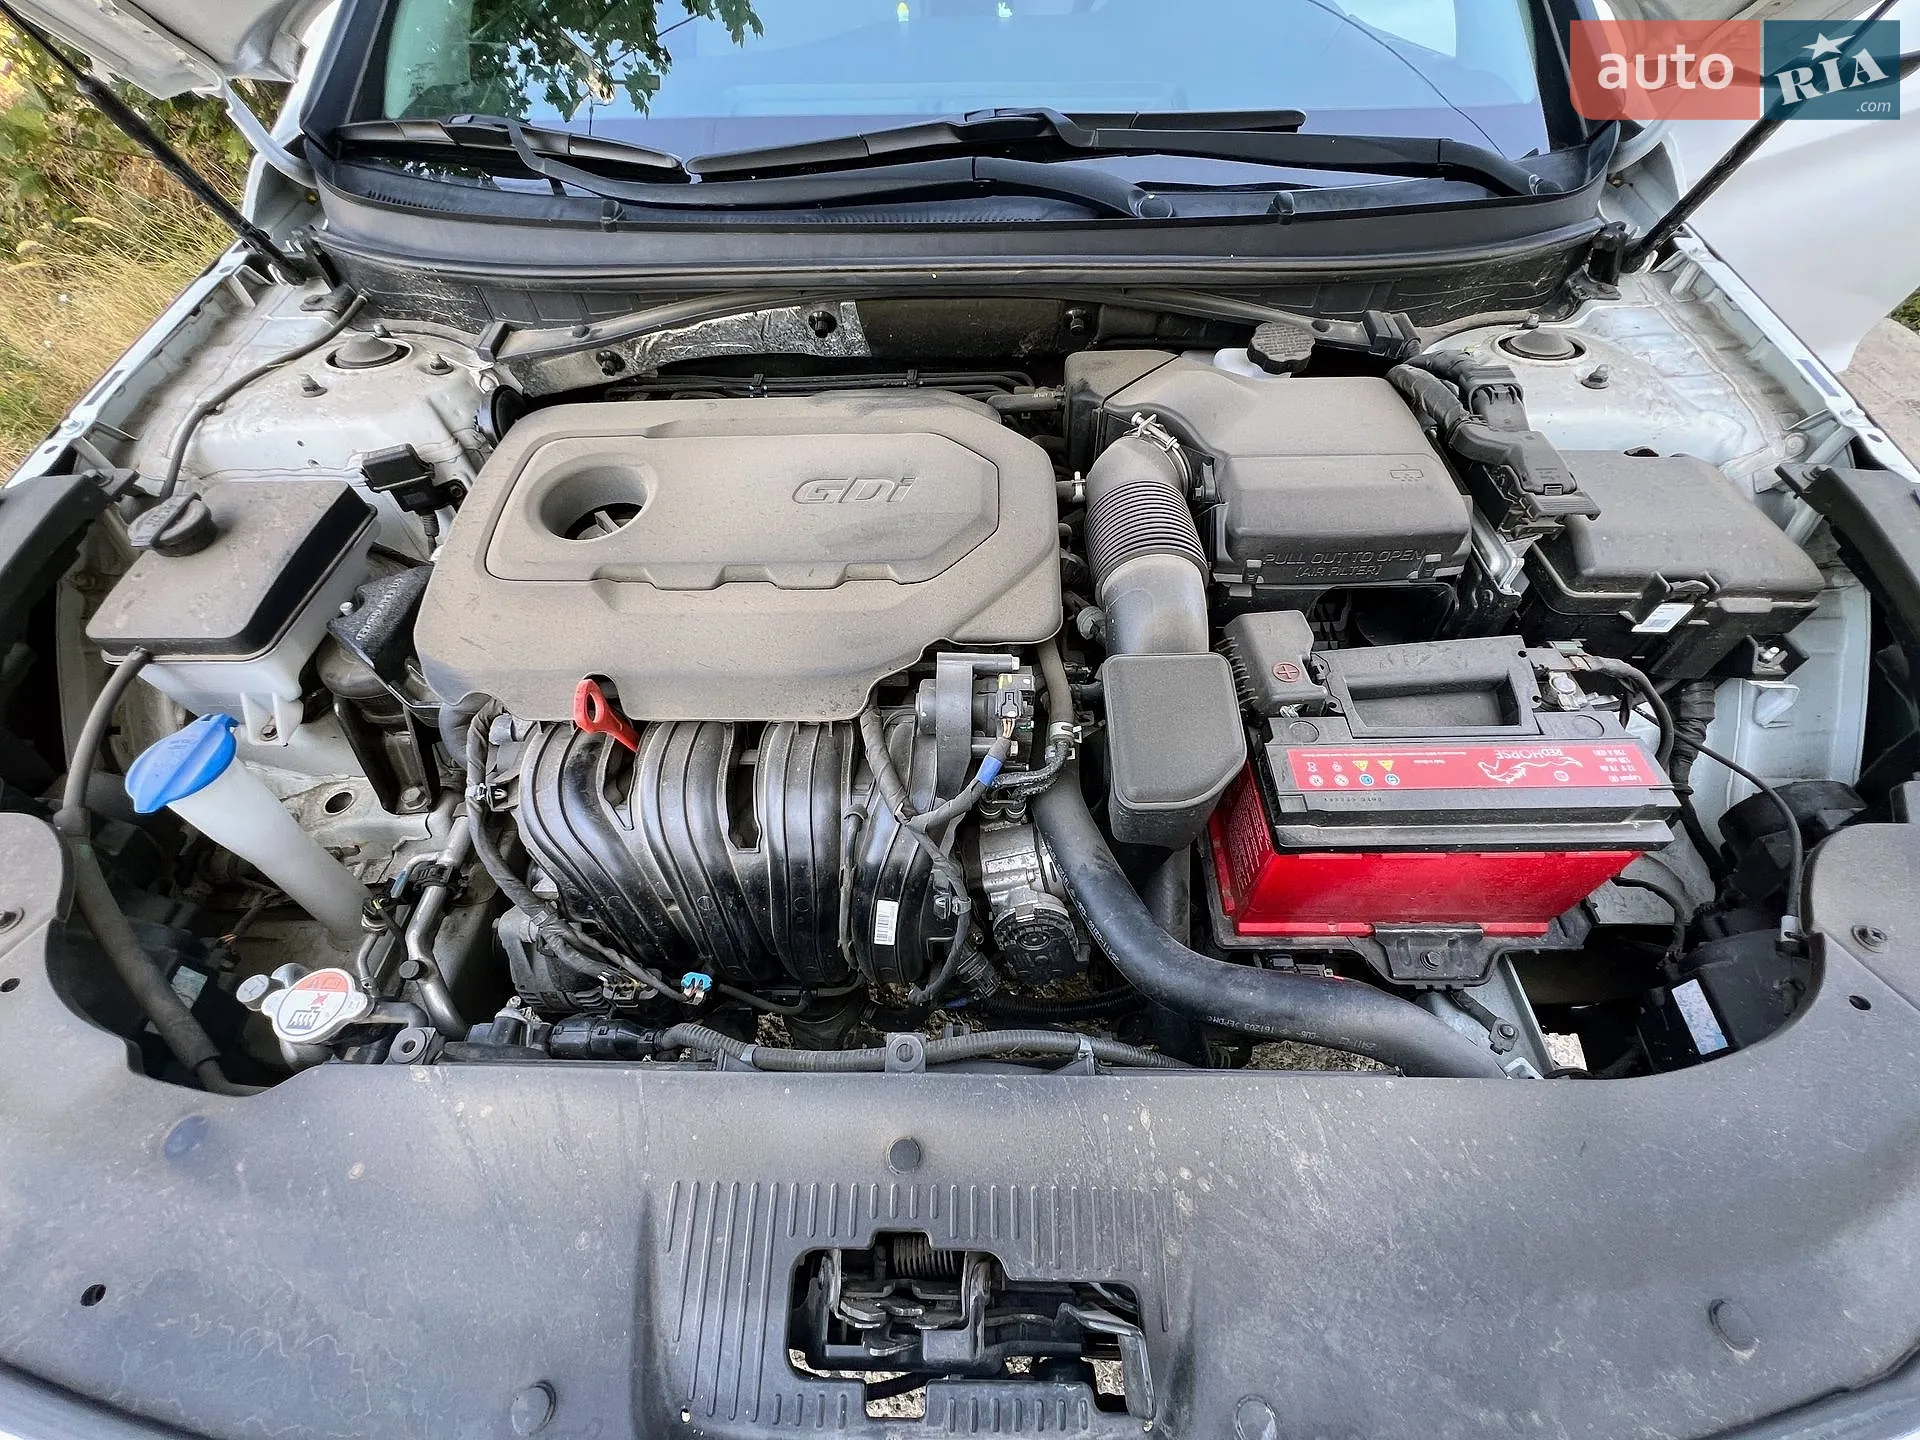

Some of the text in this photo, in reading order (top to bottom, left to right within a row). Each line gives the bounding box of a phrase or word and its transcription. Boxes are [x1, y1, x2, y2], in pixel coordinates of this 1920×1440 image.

[791, 476, 917, 505] GDi
[1262, 549, 1426, 565] PULL OUT TO OPEN
[1295, 564, 1382, 578] (AIR FILTER)
[1496, 748, 1565, 760] REDHORSE
